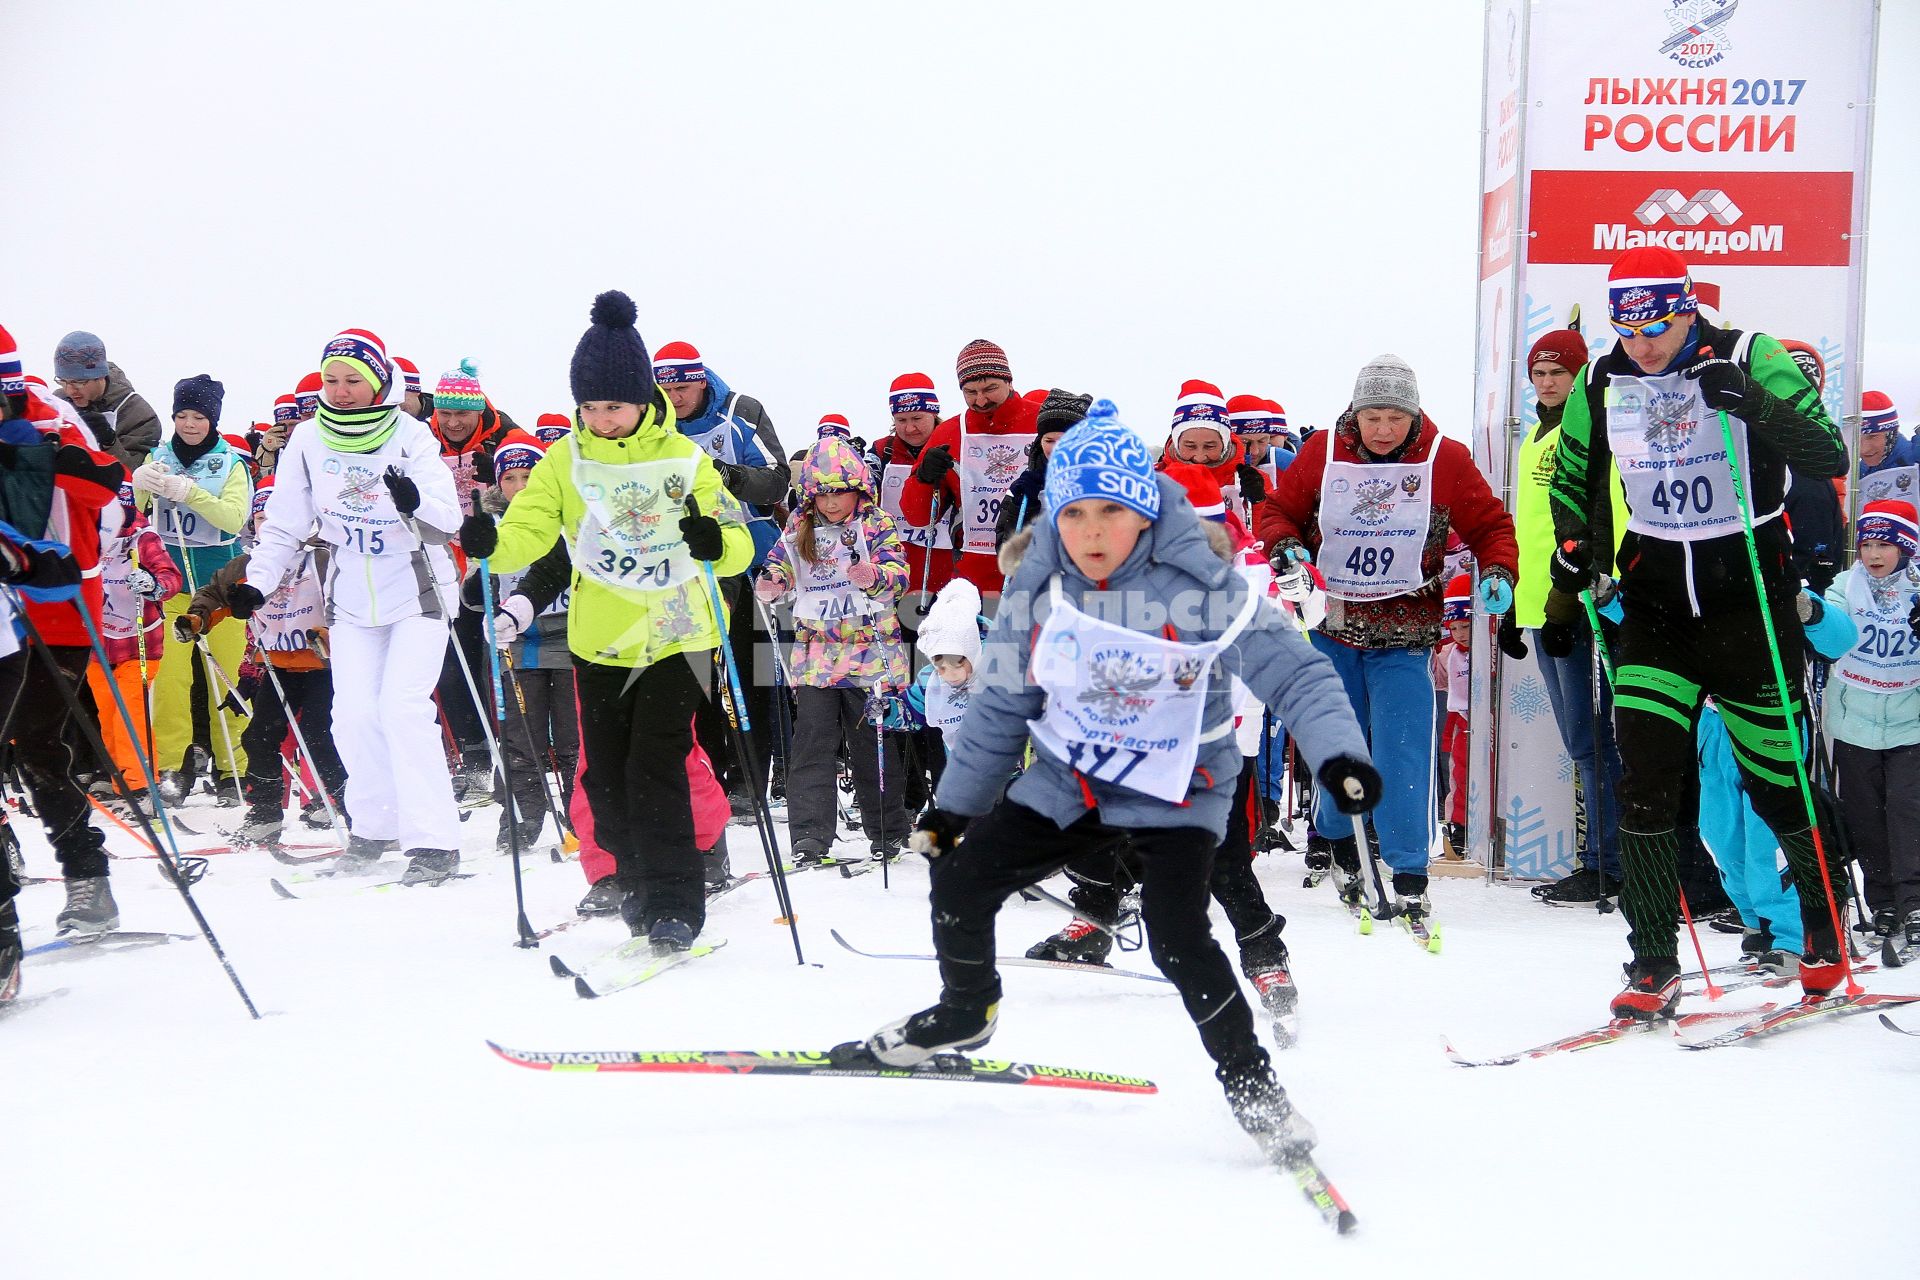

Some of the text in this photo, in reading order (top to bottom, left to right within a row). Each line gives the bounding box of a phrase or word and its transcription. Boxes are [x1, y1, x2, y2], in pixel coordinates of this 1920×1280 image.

[1681, 43, 1714, 55] 2017
[1669, 52, 1724, 69] РОССИИ
[1584, 78, 1807, 106] ЛЫЖНЯ 2017
[1584, 114, 1796, 153] РОССИИ
[1593, 223, 1783, 254] МаксидоМ
[1619, 310, 1658, 322] 2017
[898, 405, 922, 413] 2017
[1675, 421, 1698, 430] 2017
[1651, 438, 1692, 453] РОССИИ
[505, 461, 529, 470] 2017
[988, 475, 1014, 484] РОССИИ
[1358, 478, 1391, 489] ЛЫЖНЯ
[614, 480, 652, 495] ЛЫЖНЯ
[1652, 475, 1714, 515] 490
[342, 500, 374, 513] РОССИИ
[641, 514, 662, 523] 2017
[1356, 515, 1390, 526] РОССИИ
[1701, 515, 1738, 526] область
[615, 529, 656, 542] РОССИИ
[1862, 533, 1890, 541] 2017
[1345, 546, 1395, 577] 489
[818, 593, 857, 620] 744
[1871, 679, 1904, 689] РОССИИ
[1124, 697, 1155, 706] 2017
[1083, 706, 1140, 726] РОССИИ
